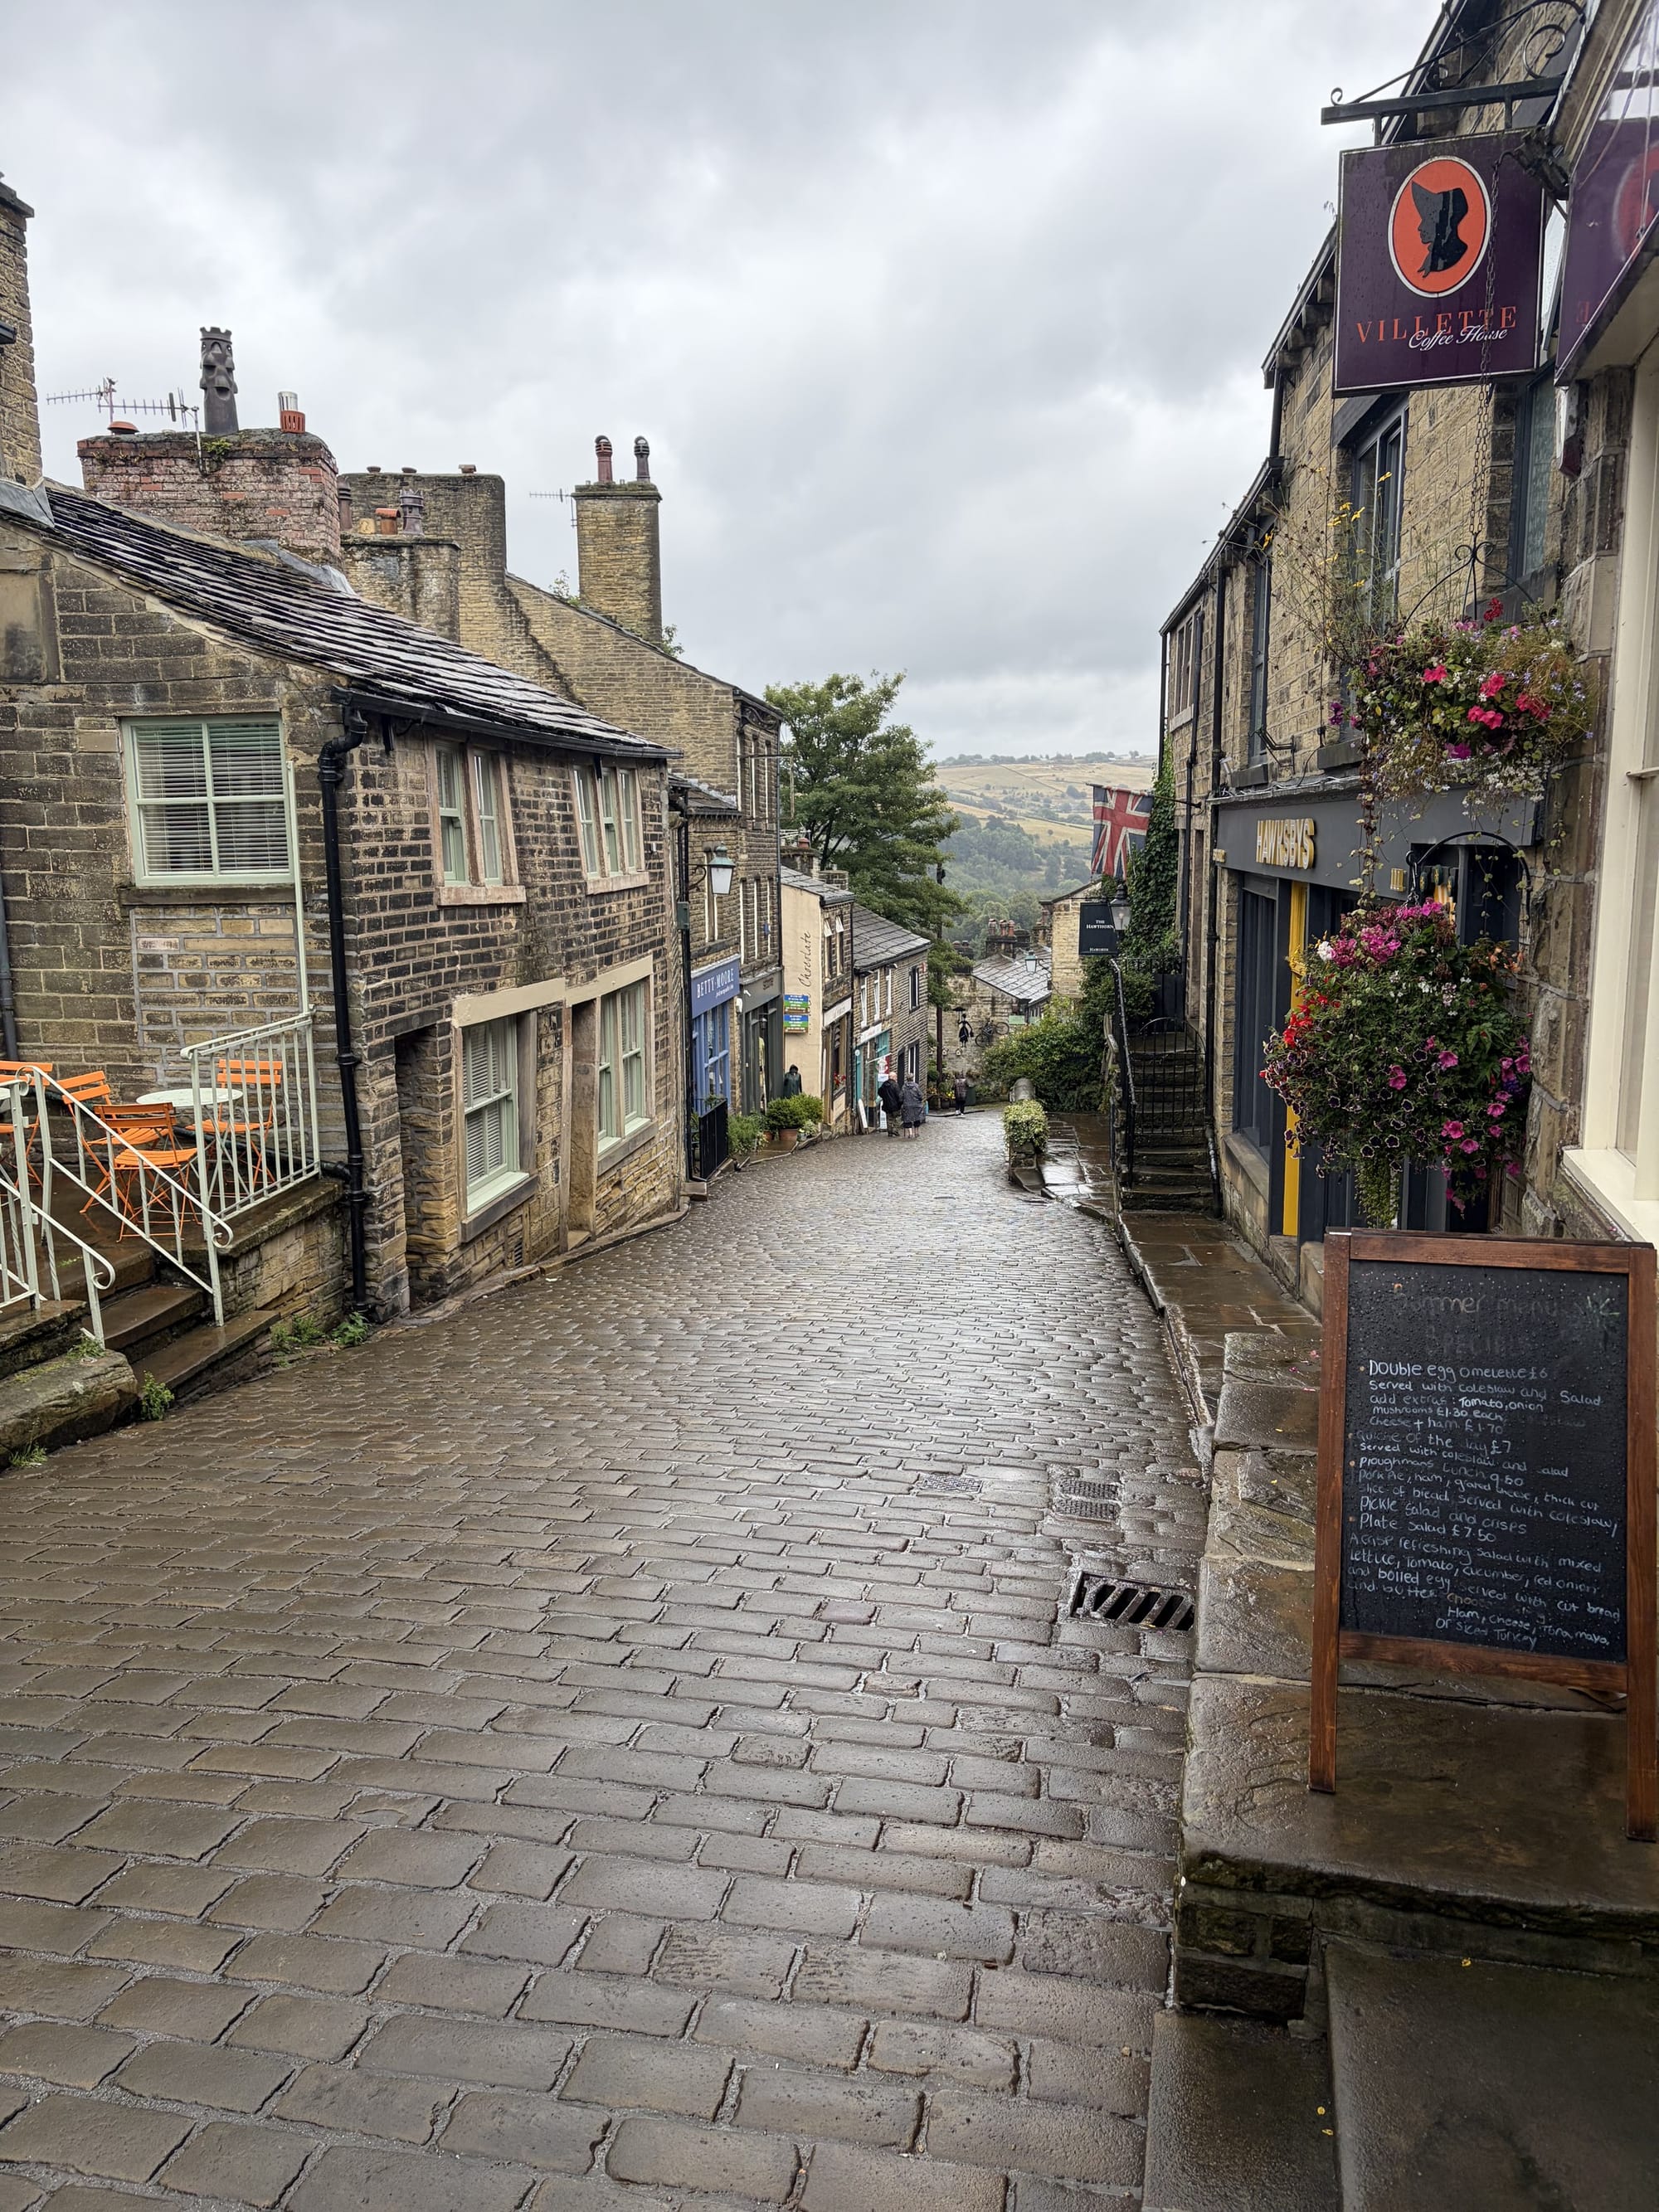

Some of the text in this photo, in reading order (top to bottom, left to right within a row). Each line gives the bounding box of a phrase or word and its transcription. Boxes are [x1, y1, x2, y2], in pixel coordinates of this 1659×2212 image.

[1356, 306, 1516, 343] VILLETTE
[1408, 323, 1508, 352] Coffee House
[1256, 818, 1315, 869] HAWKSBYS
[798, 931, 811, 987] Chocolate
[1369, 1359, 1423, 1377] Double
[1427, 1364, 1457, 1384] egg
[1370, 1393, 1397, 1405] add
[1421, 1383, 1453, 1393] with
[1520, 1387, 1547, 1402] and
[1408, 1446, 1438, 1457] with
[1502, 1461, 1527, 1472] and
[1427, 1434, 1453, 1449] the
[1490, 1440, 1512, 1456] £7
[1359, 1512, 1399, 1530] Plate
[1452, 1524, 1497, 1543] £7.50
[1448, 1512, 1478, 1525] and
[1399, 1536, 1473, 1567] refreshing
[1558, 1557, 1603, 1573] mixed
[1378, 1568, 1421, 1586] boiled
[1515, 1592, 1548, 1608] with
[1586, 1602, 1620, 1623] bread
